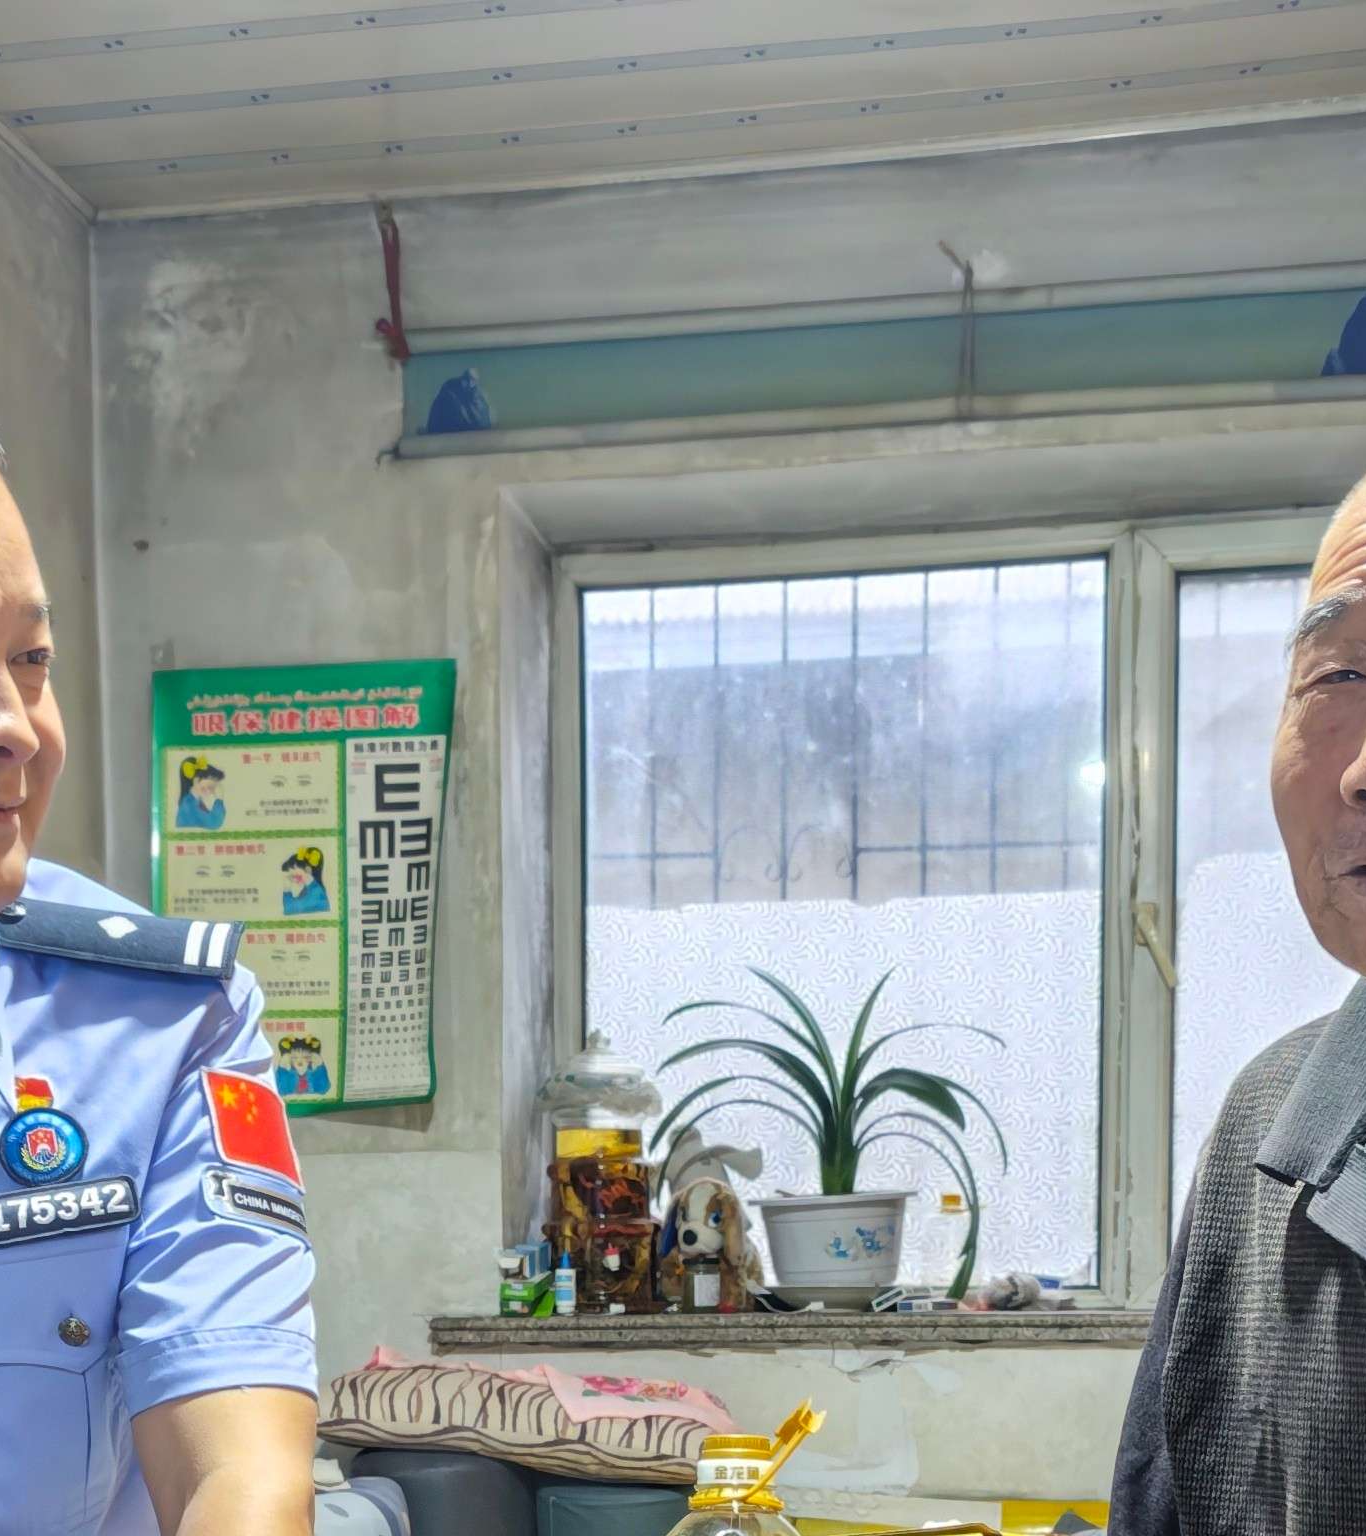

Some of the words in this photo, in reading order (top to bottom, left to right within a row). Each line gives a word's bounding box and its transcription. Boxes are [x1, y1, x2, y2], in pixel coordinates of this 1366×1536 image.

[191, 704, 420, 736] 眼保健操图解
[233, 1192, 271, 1211] CHINA
[714, 1464, 760, 1480] 金龙鱼
